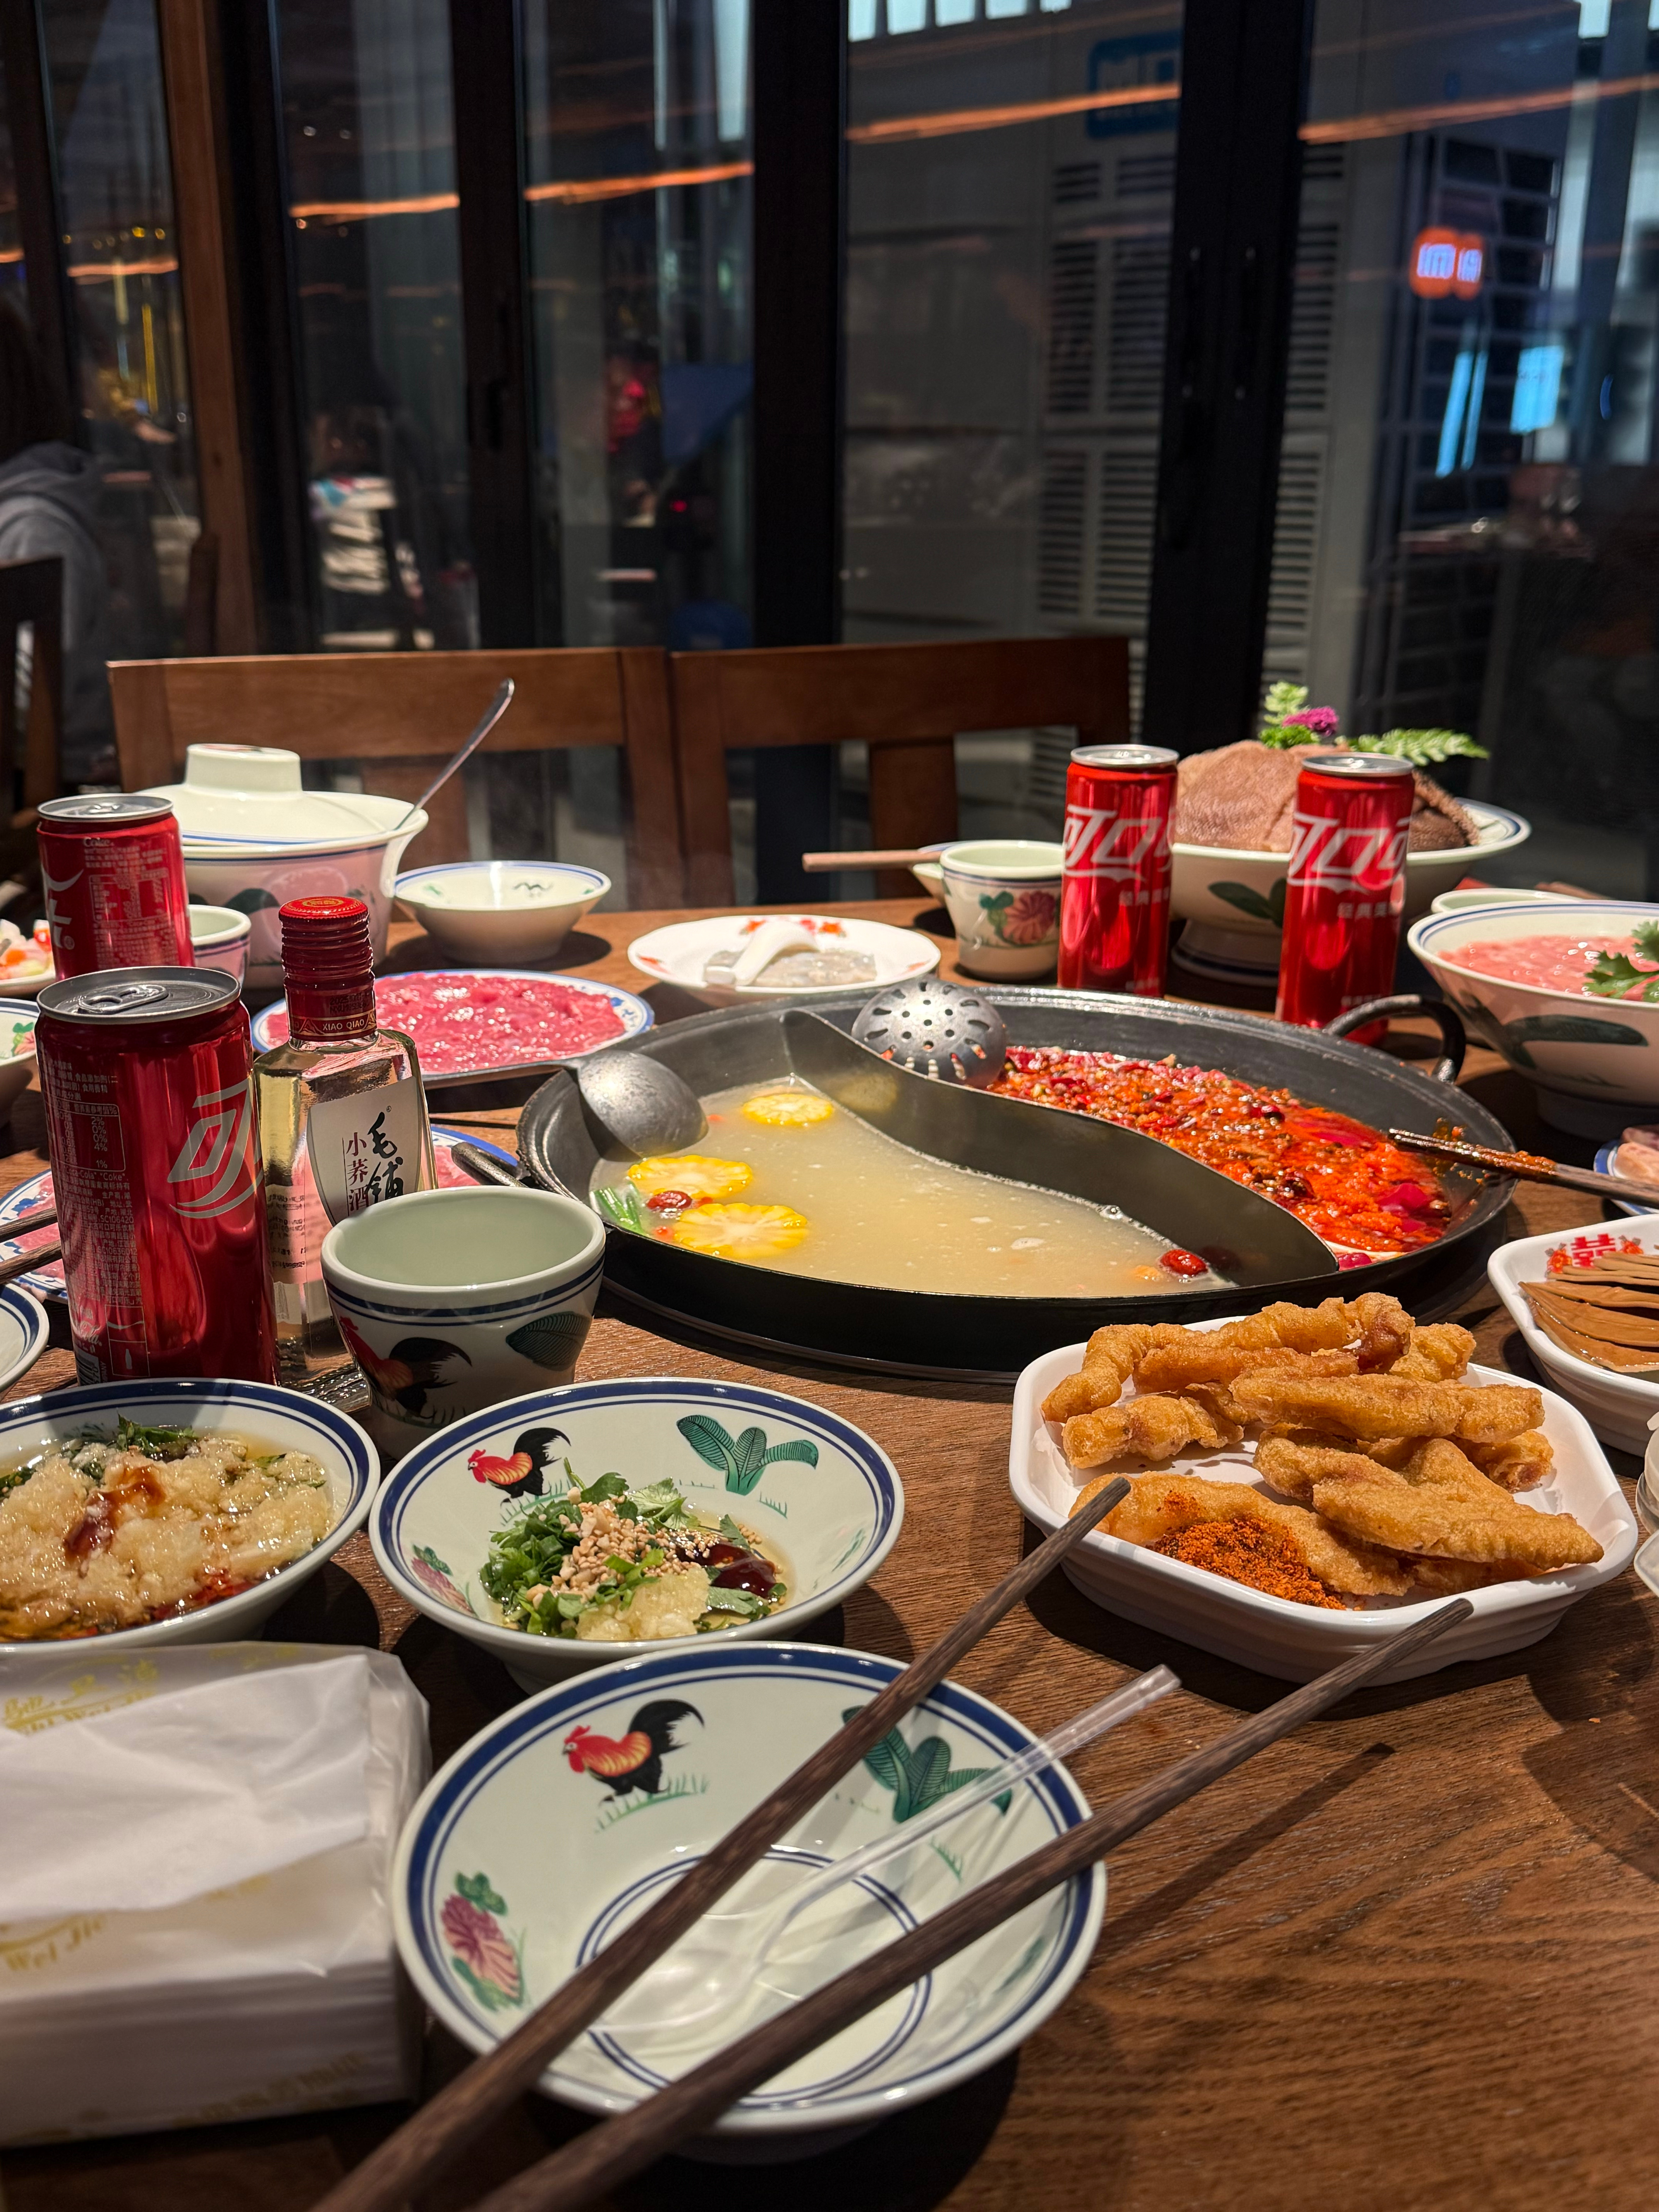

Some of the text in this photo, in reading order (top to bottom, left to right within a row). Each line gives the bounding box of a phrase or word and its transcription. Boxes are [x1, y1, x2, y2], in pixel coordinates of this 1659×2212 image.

[346, 1019, 364, 1030] QIAO
[91, 1116, 105, 1126] 2%
[346, 1132, 369, 1211] 小荞酒
